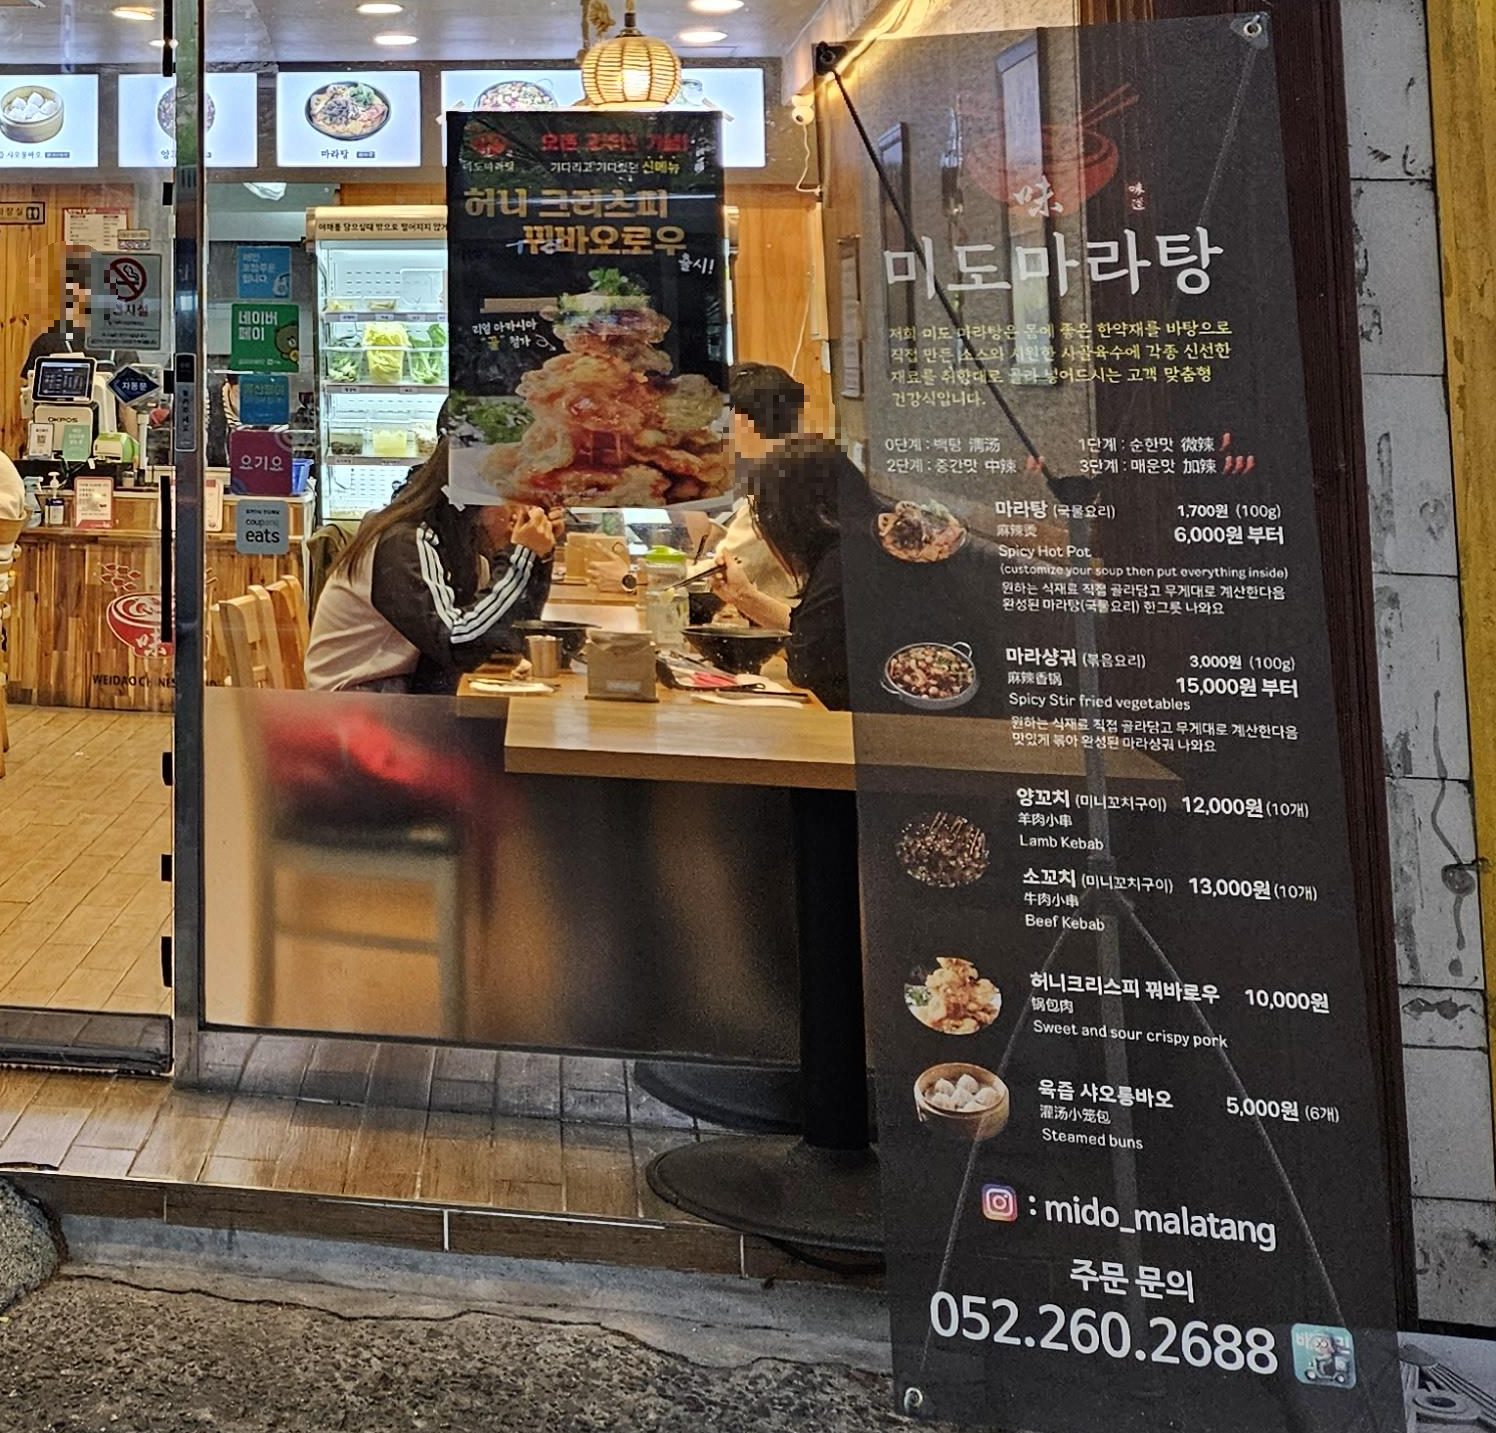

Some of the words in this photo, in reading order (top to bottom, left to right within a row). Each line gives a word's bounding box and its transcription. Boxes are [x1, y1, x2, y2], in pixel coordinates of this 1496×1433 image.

[321, 149, 349, 160] 마라탕
[641, 159, 681, 174] 신메뉴
[463, 188, 528, 218] 허니
[538, 188, 670, 218] 크리스피
[883, 225, 1224, 300] 미도마라탕
[238, 310, 278, 326] 네이버
[238, 327, 265, 342] 페이
[889, 326, 916, 341] 저희
[922, 325, 953, 340] 미도
[1060, 322, 1092, 339] 좋은
[1097, 320, 1161, 338] 한약재를
[1166, 320, 1233, 337] 바탕으로
[891, 347, 918, 363] 직접
[923, 347, 954, 363] 만든
[1146, 344, 1179, 361] 각종
[1183, 342, 1232, 360] 신선한
[891, 369, 938, 385] 재료를
[1127, 366, 1158, 383] 고객
[1164, 366, 1213, 384] 맞춤형
[122, 381, 148, 392] 자동문
[892, 390, 987, 408] 건강식입니다.
[885, 437, 922, 452] 0단계
[1078, 438, 1117, 453] 1단계
[1130, 437, 1173, 453] 순한맛
[240, 456, 284, 471] 요기요
[887, 458, 924, 474] 2단계
[936, 458, 978, 474] 중간맛
[1080, 458, 1119, 474] 3단계
[1131, 458, 1175, 474] 매운맛
[995, 500, 1047, 519] 마라탕
[1053, 504, 1116, 520] (국물요리)
[1177, 503, 1228, 519] 1,700원
[1236, 504, 1281, 520] (100g)
[246, 529, 280, 543] eats
[1174, 526, 1243, 545] 6,000원
[1248, 526, 1284, 545] 부터
[999, 545, 1035, 559] Spicy
[1038, 545, 1064, 558] Hot
[1067, 545, 1092, 558] Pot
[1066, 566, 1092, 578] your
[1095, 566, 1123, 578] soup
[1126, 566, 1154, 578] then
[1157, 566, 1177, 579] put
[1180, 566, 1246, 580] everything
[1249, 566, 1289, 580] inside)
[1003, 581, 1039, 595] 원하는
[1165, 584, 1217, 599] 무게대로
[1220, 585, 1286, 600] 계산한다음
[1003, 598, 1040, 612] 완성된
[1186, 601, 1225, 615] 나와요
[1006, 647, 1077, 667] 마라샹궈
[1189, 654, 1242, 670] 3,000원
[1249, 655, 1296, 672] (100g)
[93, 673, 137, 686] WEIDAO
[1176, 677, 1257, 698] 15,000원
[1261, 678, 1300, 699] 부터
[1008, 692, 1046, 709] Spicy
[1049, 693, 1076, 707] Stir
[1079, 694, 1113, 709] fried
[1116, 696, 1191, 711] vegetables
[1011, 716, 1049, 731] 원하는
[1176, 721, 1229, 737] 무게대로
[1231, 723, 1299, 740] 계산한다음
[1012, 732, 1050, 747] 맛있게
[1082, 735, 1120, 750] 완성된
[1177, 738, 1217, 754] 나와요
[1016, 787, 1071, 808] 양꼬치
[1075, 794, 1168, 813] (미니꼬치구이)
[1182, 795, 1264, 818] 12,000원
[1266, 801, 1309, 819] (10개)
[1017, 812, 1073, 828] 羊肉小串
[1019, 834, 1058, 849] Lamb
[1061, 836, 1105, 851] Kebab
[1022, 867, 1077, 888] 소꼬치
[1081, 874, 1174, 895] (미니꼬치구이)
[1188, 877, 1272, 901] 13,000원
[1273, 883, 1318, 903] (10개)
[1023, 891, 1080, 908] 牛肉小串
[1025, 913, 1059, 929] Beef
[1062, 916, 1106, 932] Kebab
[1030, 971, 1141, 998] 허니크리스피
[1245, 988, 1331, 1014] 10,000원
[1033, 1019, 1078, 1037] Sweet
[1081, 1023, 1107, 1039] and
[1110, 1027, 1143, 1041] sour
[1146, 1028, 1190, 1048] crispy
[1193, 1032, 1229, 1049] pork
[1038, 1078, 1075, 1102] 육즙
[1080, 1080, 1175, 1109] 샤오롱바오
[1225, 1095, 1300, 1122] 5,000원
[1304, 1105, 1340, 1124] (6개)
[1041, 1127, 1106, 1148] Steamed
[1109, 1132, 1144, 1150] buns
[1045, 1195, 1277, 1252] mido_malatang
[1069, 1258, 1130, 1297] 주문
[1134, 1264, 1196, 1304] 문의
[929, 1290, 1280, 1376] 052.260.2688
